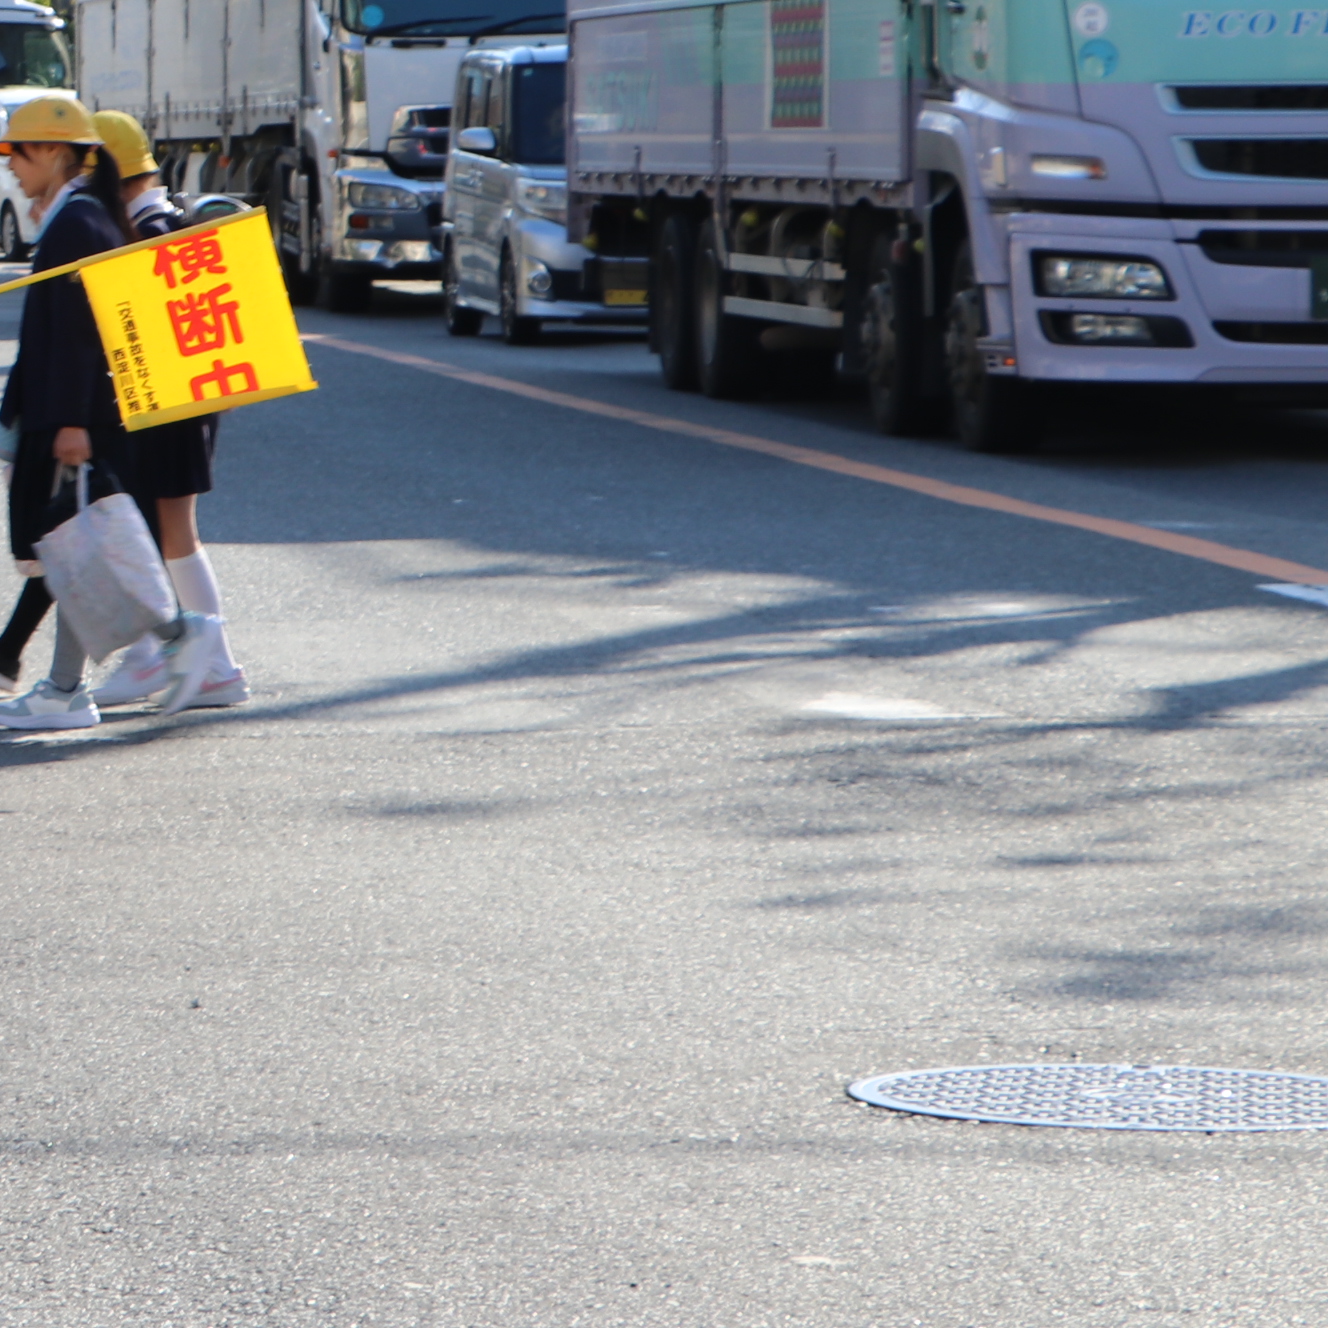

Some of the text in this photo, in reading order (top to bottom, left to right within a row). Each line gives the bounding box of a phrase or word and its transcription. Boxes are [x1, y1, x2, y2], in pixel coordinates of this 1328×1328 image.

[1180, 10, 1277, 36] ECO
[148, 228, 260, 402] 横断中
